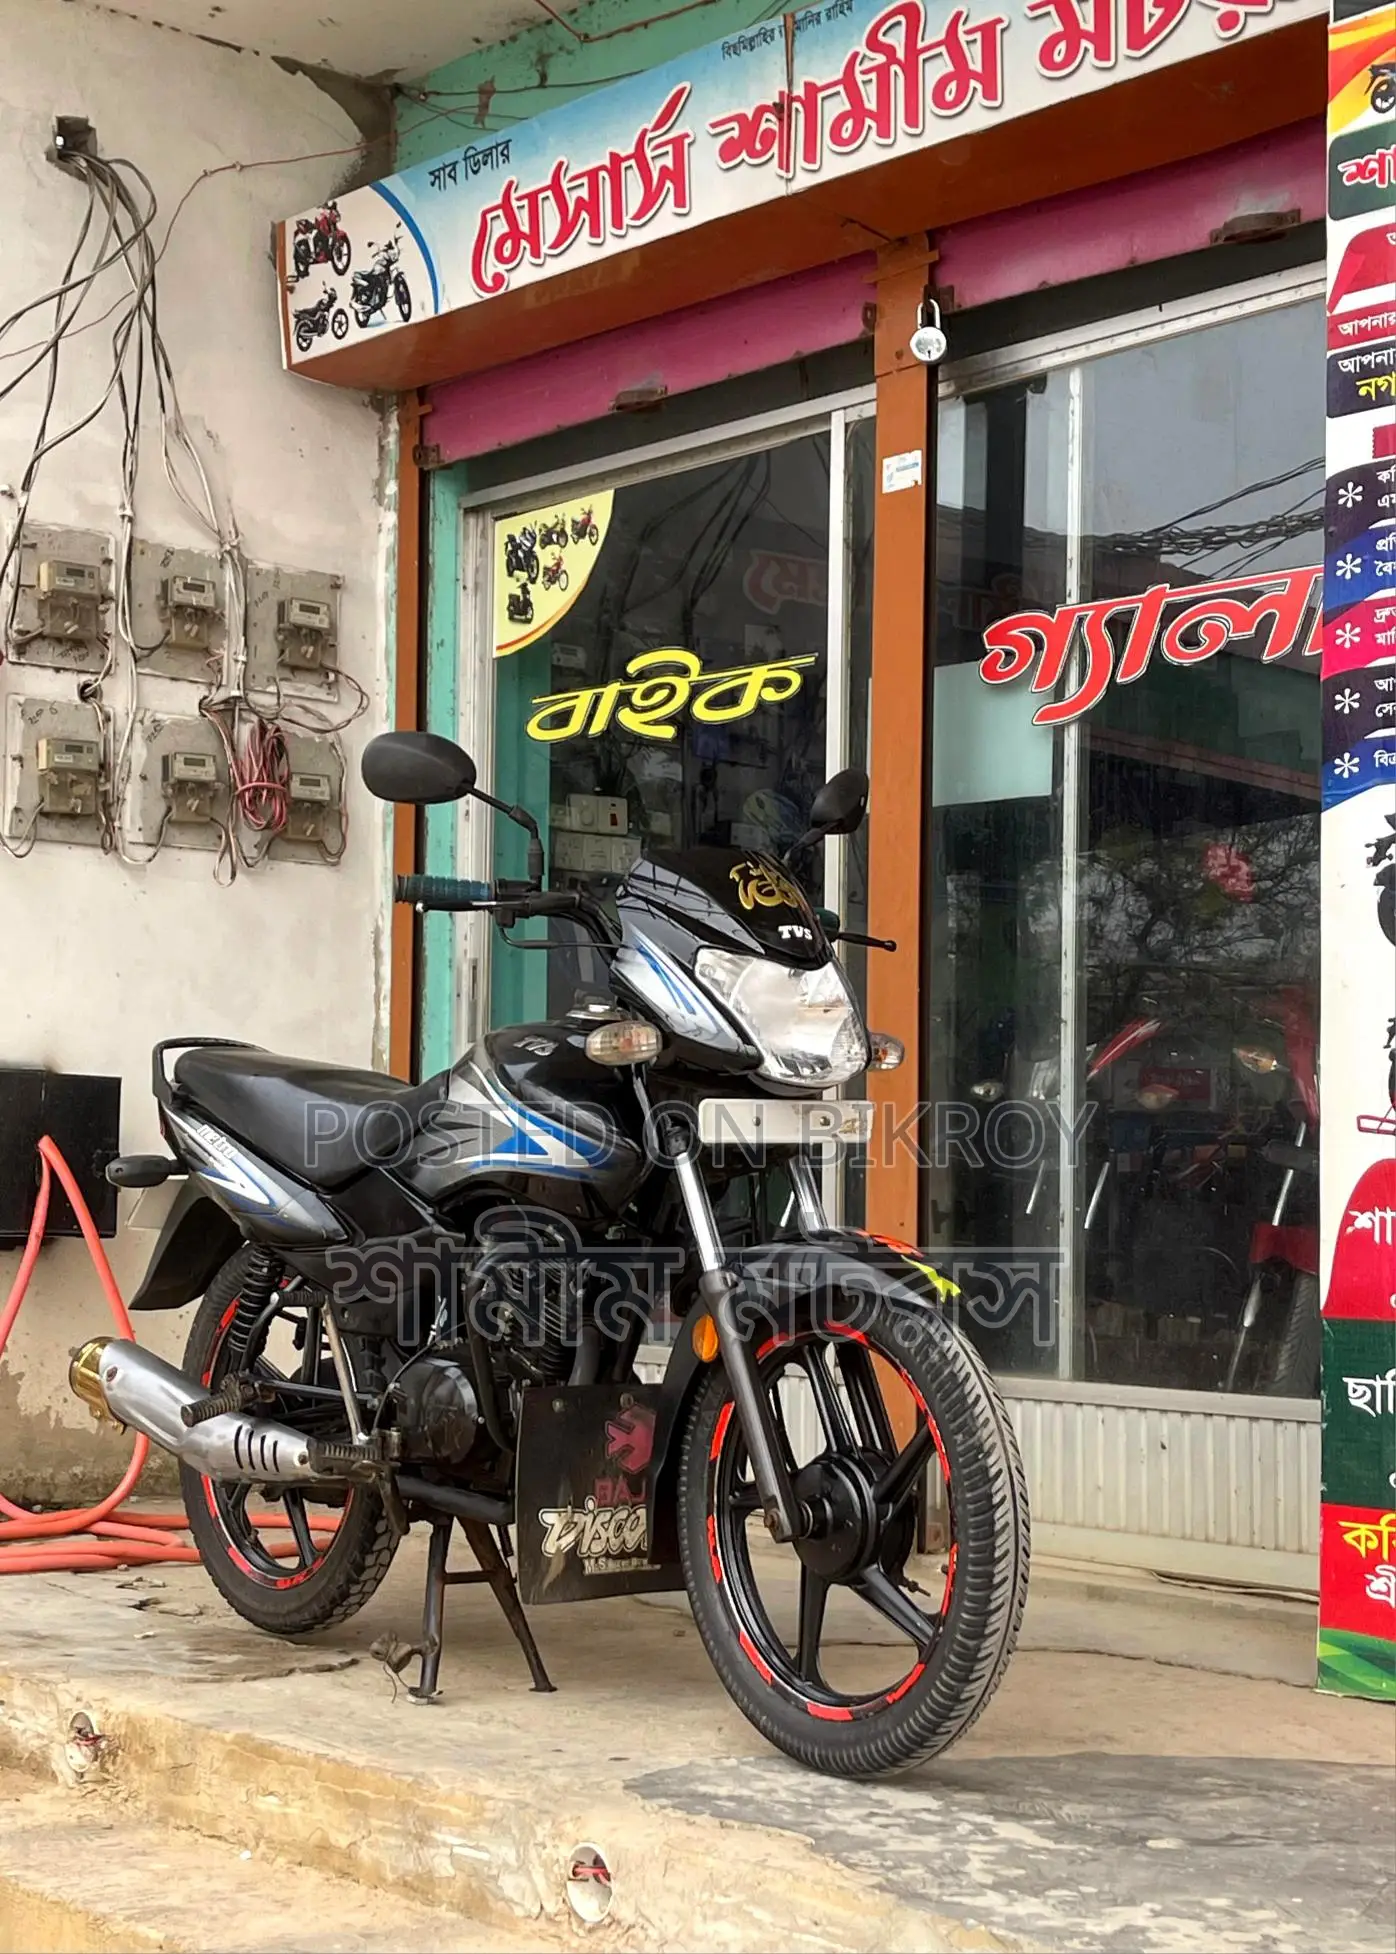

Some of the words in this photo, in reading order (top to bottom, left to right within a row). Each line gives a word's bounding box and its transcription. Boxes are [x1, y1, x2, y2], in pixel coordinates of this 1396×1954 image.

[427, 160, 460, 192] সাব
[462, 138, 513, 181] ডিলার
[468, 81, 694, 296] মেসার্স
[708, 1, 1003, 174] শামীম
[1337, 347, 1396, 374] আপনা
[526, 646, 819, 743] বাইক
[778, 925, 812, 940] TVS
